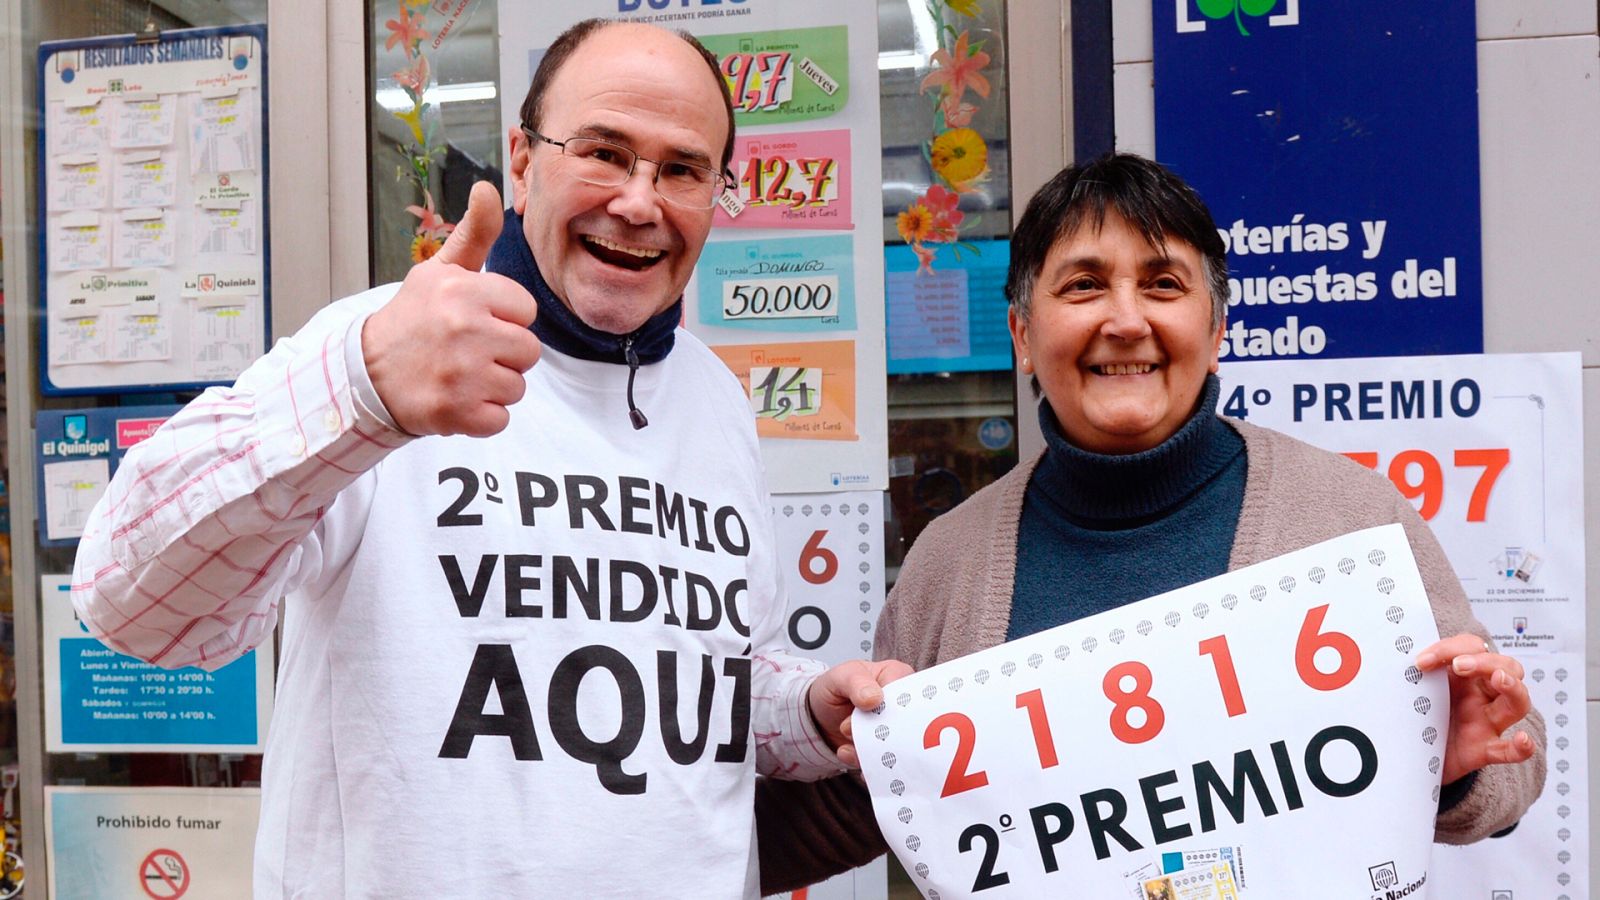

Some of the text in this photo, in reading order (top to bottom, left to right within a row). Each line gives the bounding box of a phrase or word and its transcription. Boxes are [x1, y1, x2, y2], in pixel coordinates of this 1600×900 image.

[654, 12, 695, 23] ACERTANTE
[697, 10, 724, 19] PODRÍA
[726, 7, 751, 16] GANAR
[84, 38, 224, 69] RESULTADOS SEMANALES
[799, 60, 836, 94] Jueves
[741, 155, 833, 209] 12,7
[721, 194, 741, 214] ngo
[1216, 214, 1387, 259] terías y
[749, 259, 825, 275] DOMINGO
[81, 279, 149, 290] La Primitiva
[184, 277, 257, 289] La Quiniela
[1224, 256, 1457, 316] puestas del
[724, 283, 833, 317] 50.000
[1217, 315, 1327, 358] stado
[1222, 377, 1482, 423] 4º PREMIO
[43, 438, 110, 457] El Quinigol
[436, 466, 751, 557] 2º PREMIO
[798, 529, 839, 585] 6
[1522, 633, 1555, 641] Apuestas
[80, 662, 109, 670] Lunes
[92, 674, 138, 682] Mañanas:
[93, 686, 128, 694] Tardes:
[82, 699, 122, 707] Sábados
[93, 711, 139, 719] Mañanas:
[437, 642, 752, 795] AQUÍ
[957, 725, 1379, 894] 2º PREMIO
[96, 816, 221, 829] Prohibido fumar
